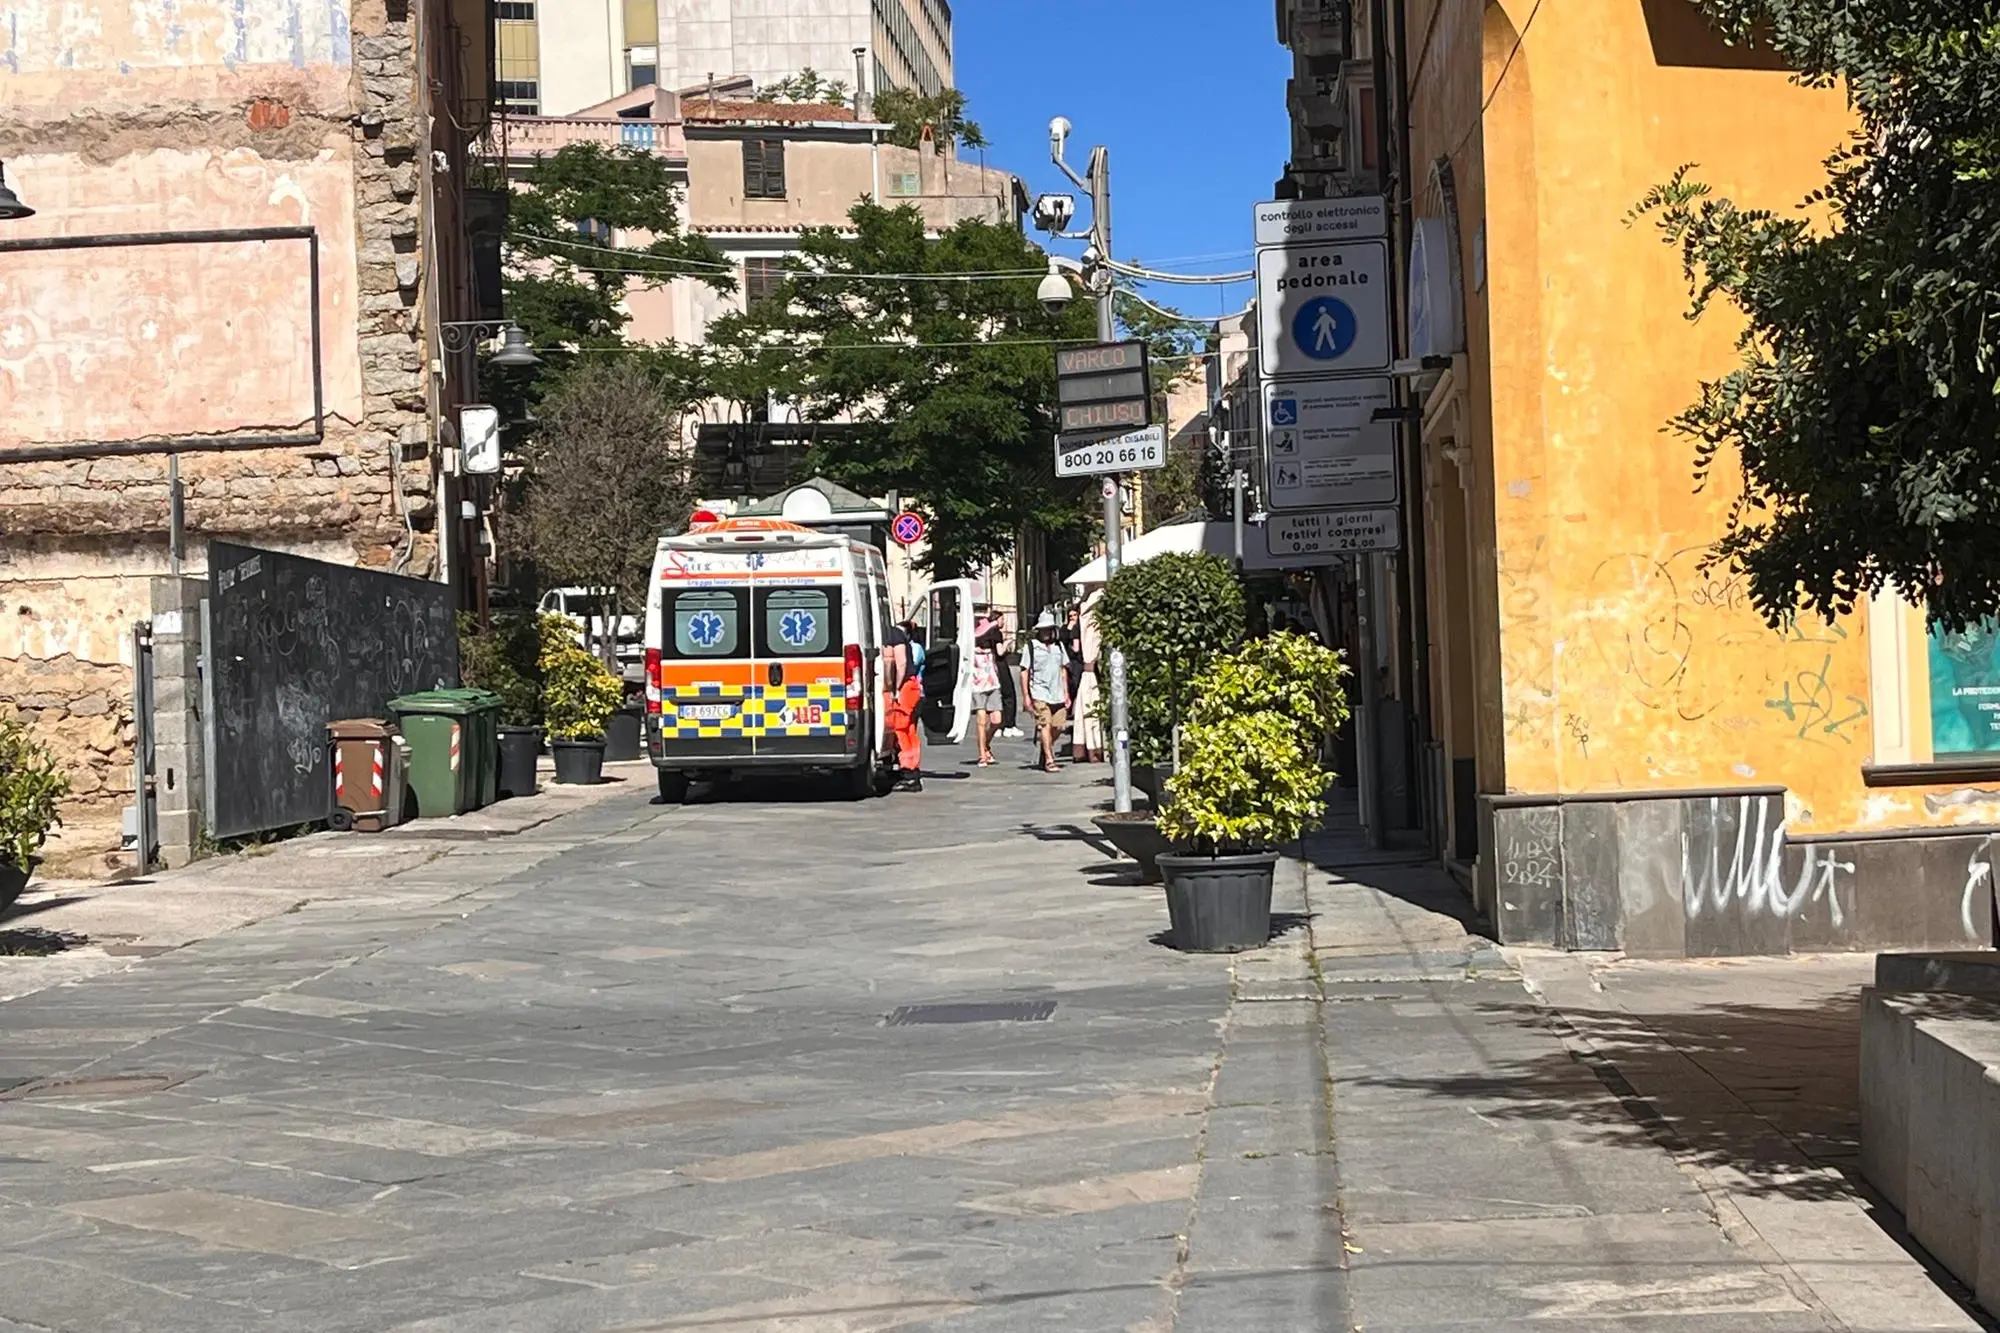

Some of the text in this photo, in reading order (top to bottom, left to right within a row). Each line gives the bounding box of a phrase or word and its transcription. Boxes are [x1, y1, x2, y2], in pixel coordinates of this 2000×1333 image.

[1260, 204, 1380, 222] controllo elettronico
[1283, 219, 1358, 235] degli accessi
[1298, 254, 1343, 268] area
[1277, 270, 1369, 292] pedonale
[1063, 347, 1125, 371] VARCO
[1124, 432, 1160, 443] DISABILI
[1064, 446, 1156, 468] 800 20 66 16
[1292, 516, 1320, 527] tutti
[1336, 513, 1373, 527] giorni
[1281, 524, 1386, 540] festivi compresi
